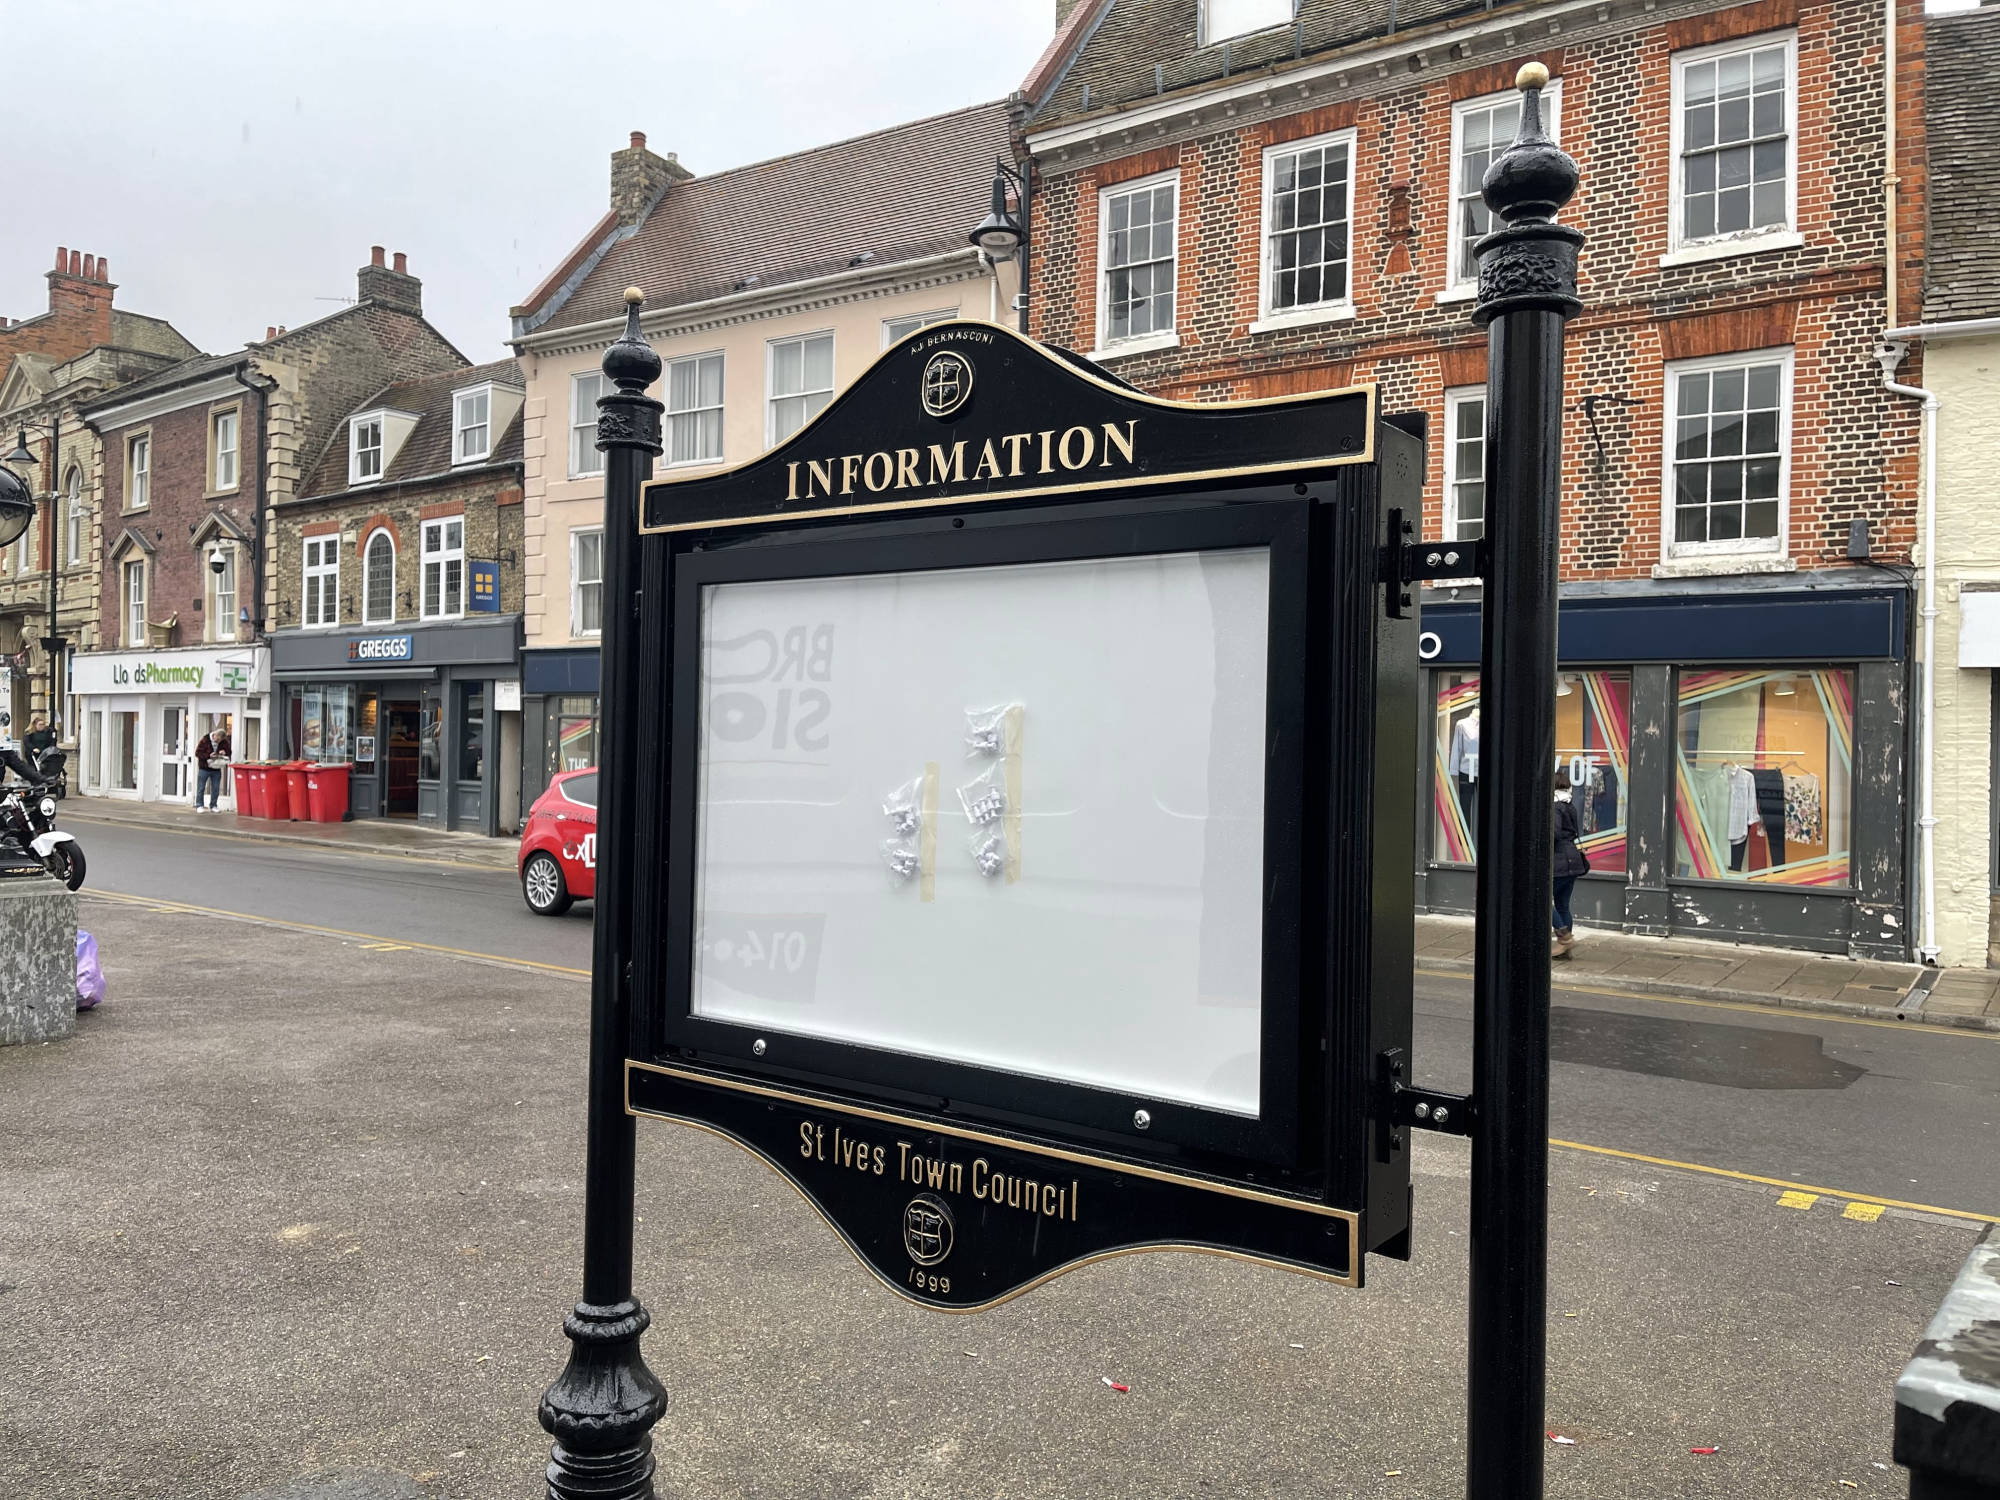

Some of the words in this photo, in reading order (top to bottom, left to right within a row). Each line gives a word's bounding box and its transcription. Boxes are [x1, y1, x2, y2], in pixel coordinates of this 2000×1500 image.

[927, 331, 995, 347] BERNASCONI
[785, 420, 1140, 500] INFORMATION
[358, 637, 408, 658] GREGGS
[1569, 755, 1601, 787] OF
[800, 1121, 825, 1161] St
[834, 1126, 885, 1176] Ives
[897, 1140, 963, 1194] Town
[972, 1158, 1079, 1222] Council
[908, 1267, 950, 1294] 1999
